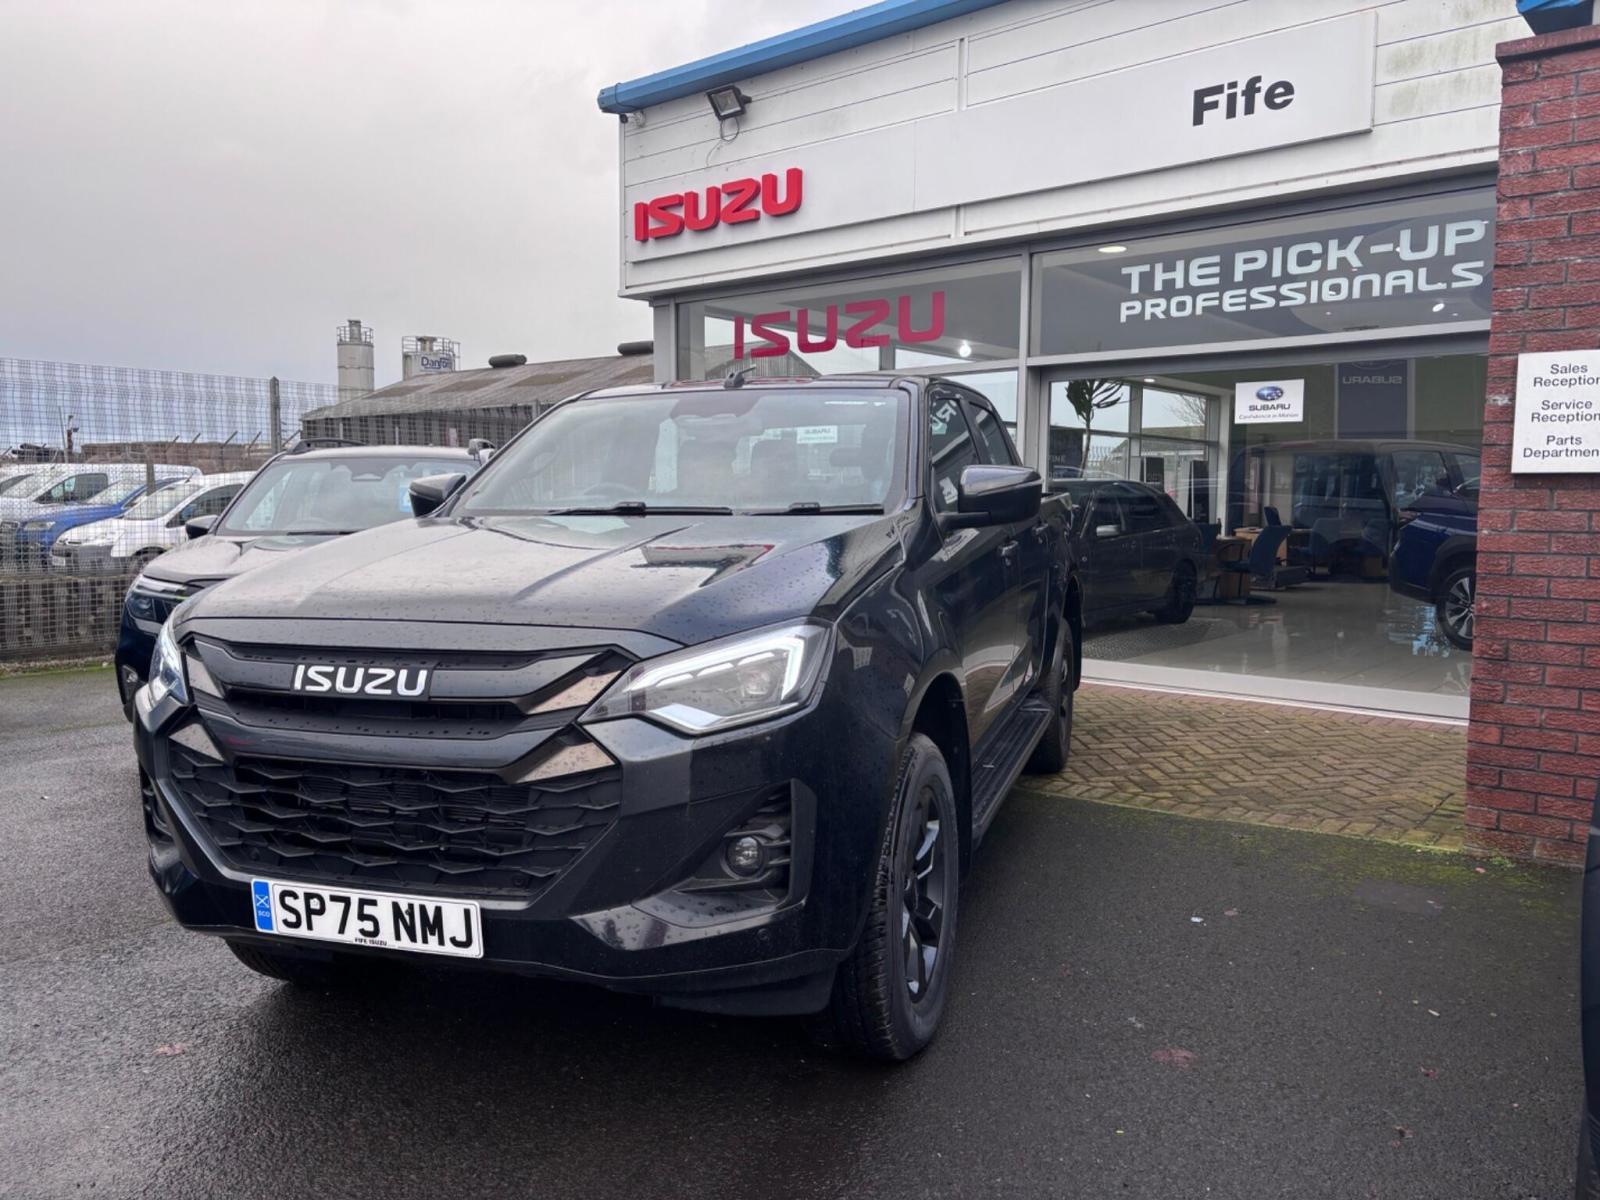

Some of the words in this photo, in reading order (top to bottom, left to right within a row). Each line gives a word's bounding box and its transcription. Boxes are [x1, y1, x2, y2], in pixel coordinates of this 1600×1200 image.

[1193, 75, 1295, 126] Fife
[634, 168, 803, 241] ISUZU
[1121, 255, 1221, 294] THE
[1233, 220, 1486, 282] PICK-UP
[1119, 261, 1485, 323] PROFESSIONALS
[733, 291, 946, 360] ISUZU
[1550, 363, 1588, 374] Sales
[1531, 411, 1600, 424] Reception
[1541, 400, 1592, 410] Service
[1523, 447, 1599, 459] Departmen
[1547, 435, 1582, 445] Parts
[294, 664, 428, 697] ISUZU
[279, 890, 380, 938] SP75
[392, 901, 473, 948] NMJ
